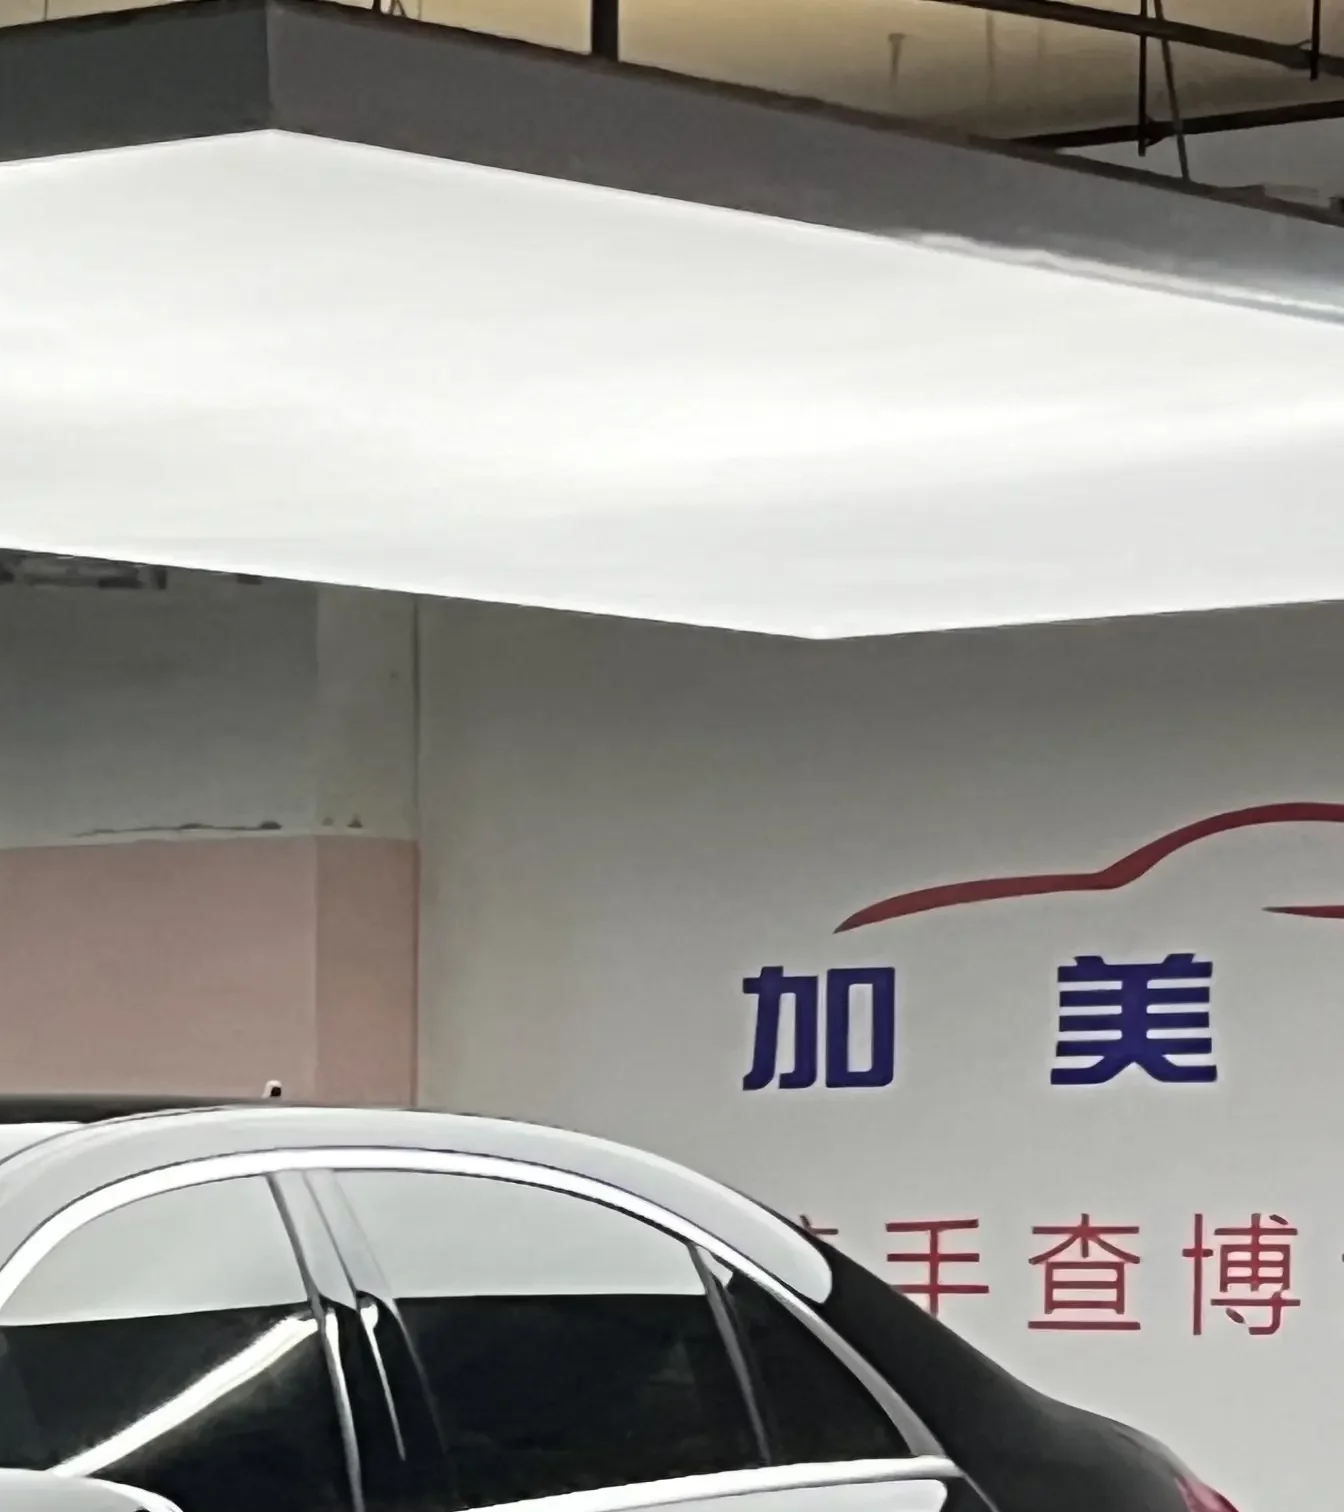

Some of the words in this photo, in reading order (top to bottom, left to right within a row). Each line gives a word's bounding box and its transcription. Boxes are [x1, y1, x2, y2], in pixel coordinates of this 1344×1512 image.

[742, 953, 1218, 1091] 加美
[799, 1213, 1344, 1336] 手查博
